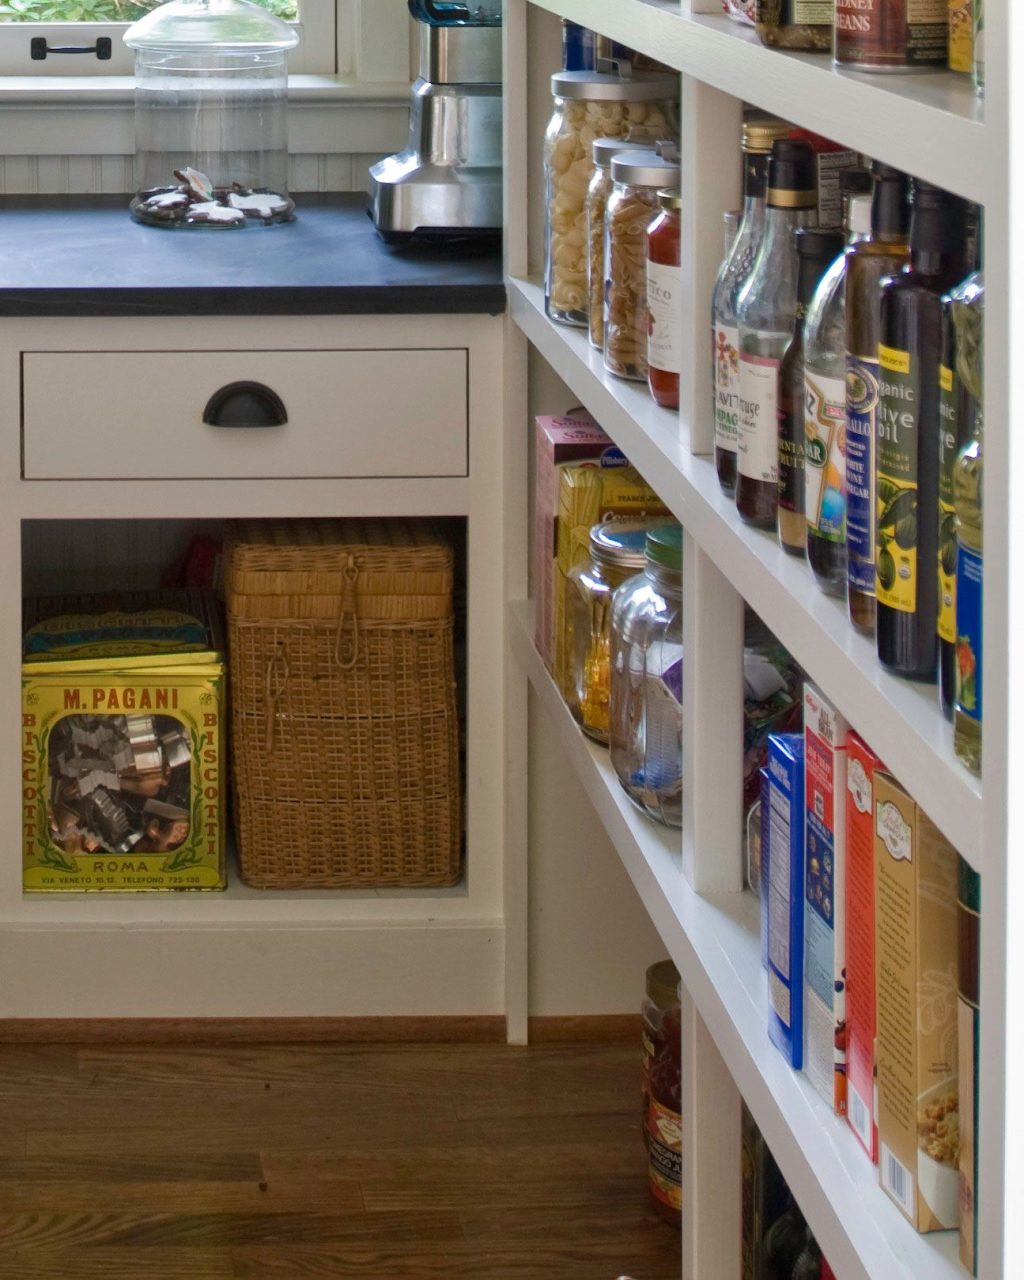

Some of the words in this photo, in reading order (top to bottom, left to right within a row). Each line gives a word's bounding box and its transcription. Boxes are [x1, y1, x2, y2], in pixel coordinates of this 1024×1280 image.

[63, 688, 87, 710] M.
[93, 687, 179, 710] PAGANI
[22, 713, 37, 856] BISCOTTI
[203, 713, 219, 855] BISCOTTI
[93, 861, 149, 873] ROMA
